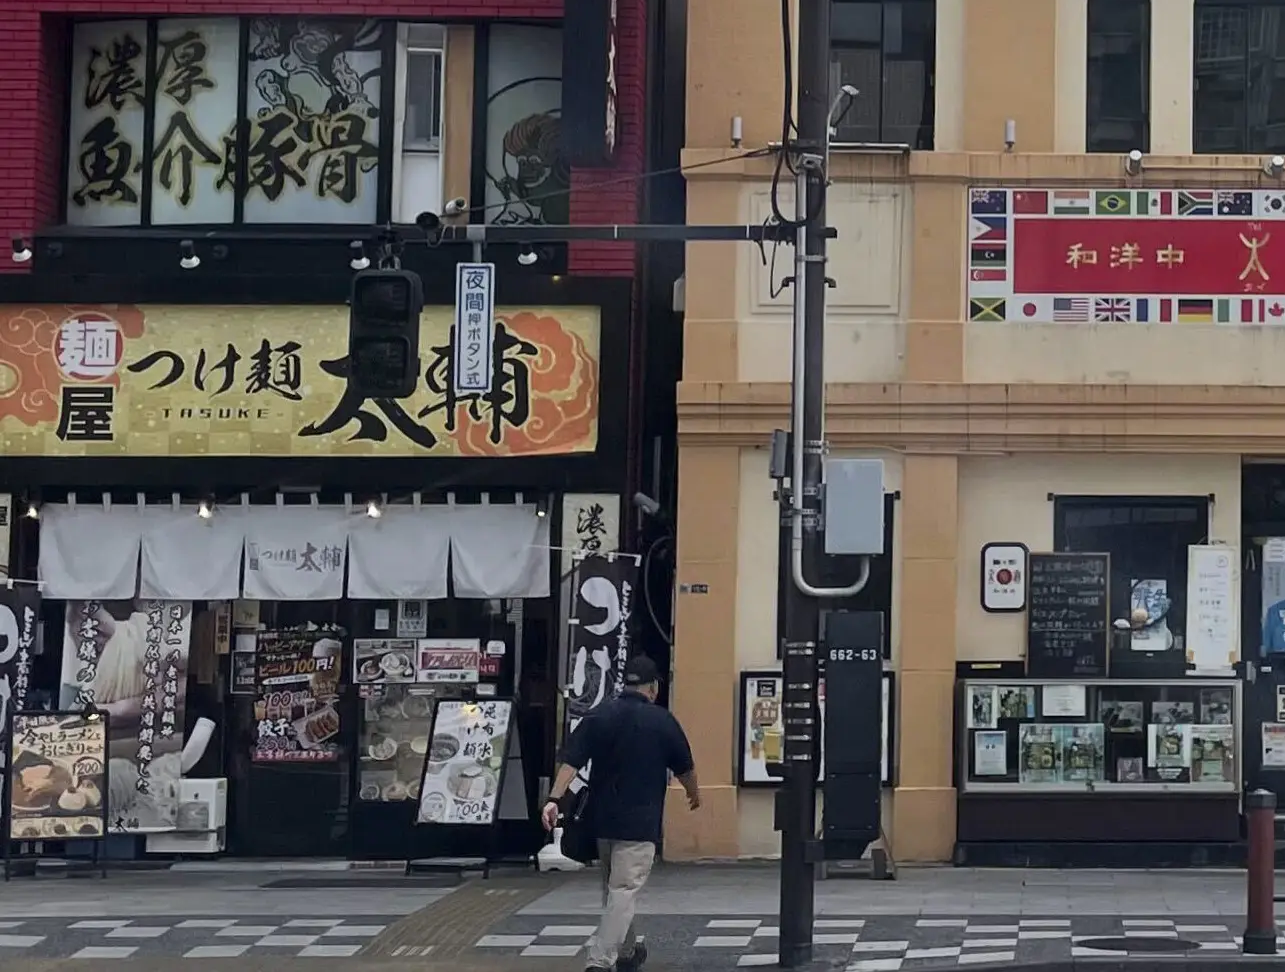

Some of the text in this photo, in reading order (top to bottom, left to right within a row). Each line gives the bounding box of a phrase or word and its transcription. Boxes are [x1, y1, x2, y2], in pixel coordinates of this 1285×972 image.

[84, 30, 216, 111] 濃厚
[73, 110, 380, 207] 魚介豚骨
[1066, 242, 1184, 270] 和洋中
[464, 270, 486, 386] 夜間押ボタン式
[56, 319, 116, 442] 麺屋
[127, 338, 303, 402] つけ麺
[162, 408, 271, 420] TASUKE
[830, 649, 877, 661] 662-63
[257, 718, 289, 738] 餃子
